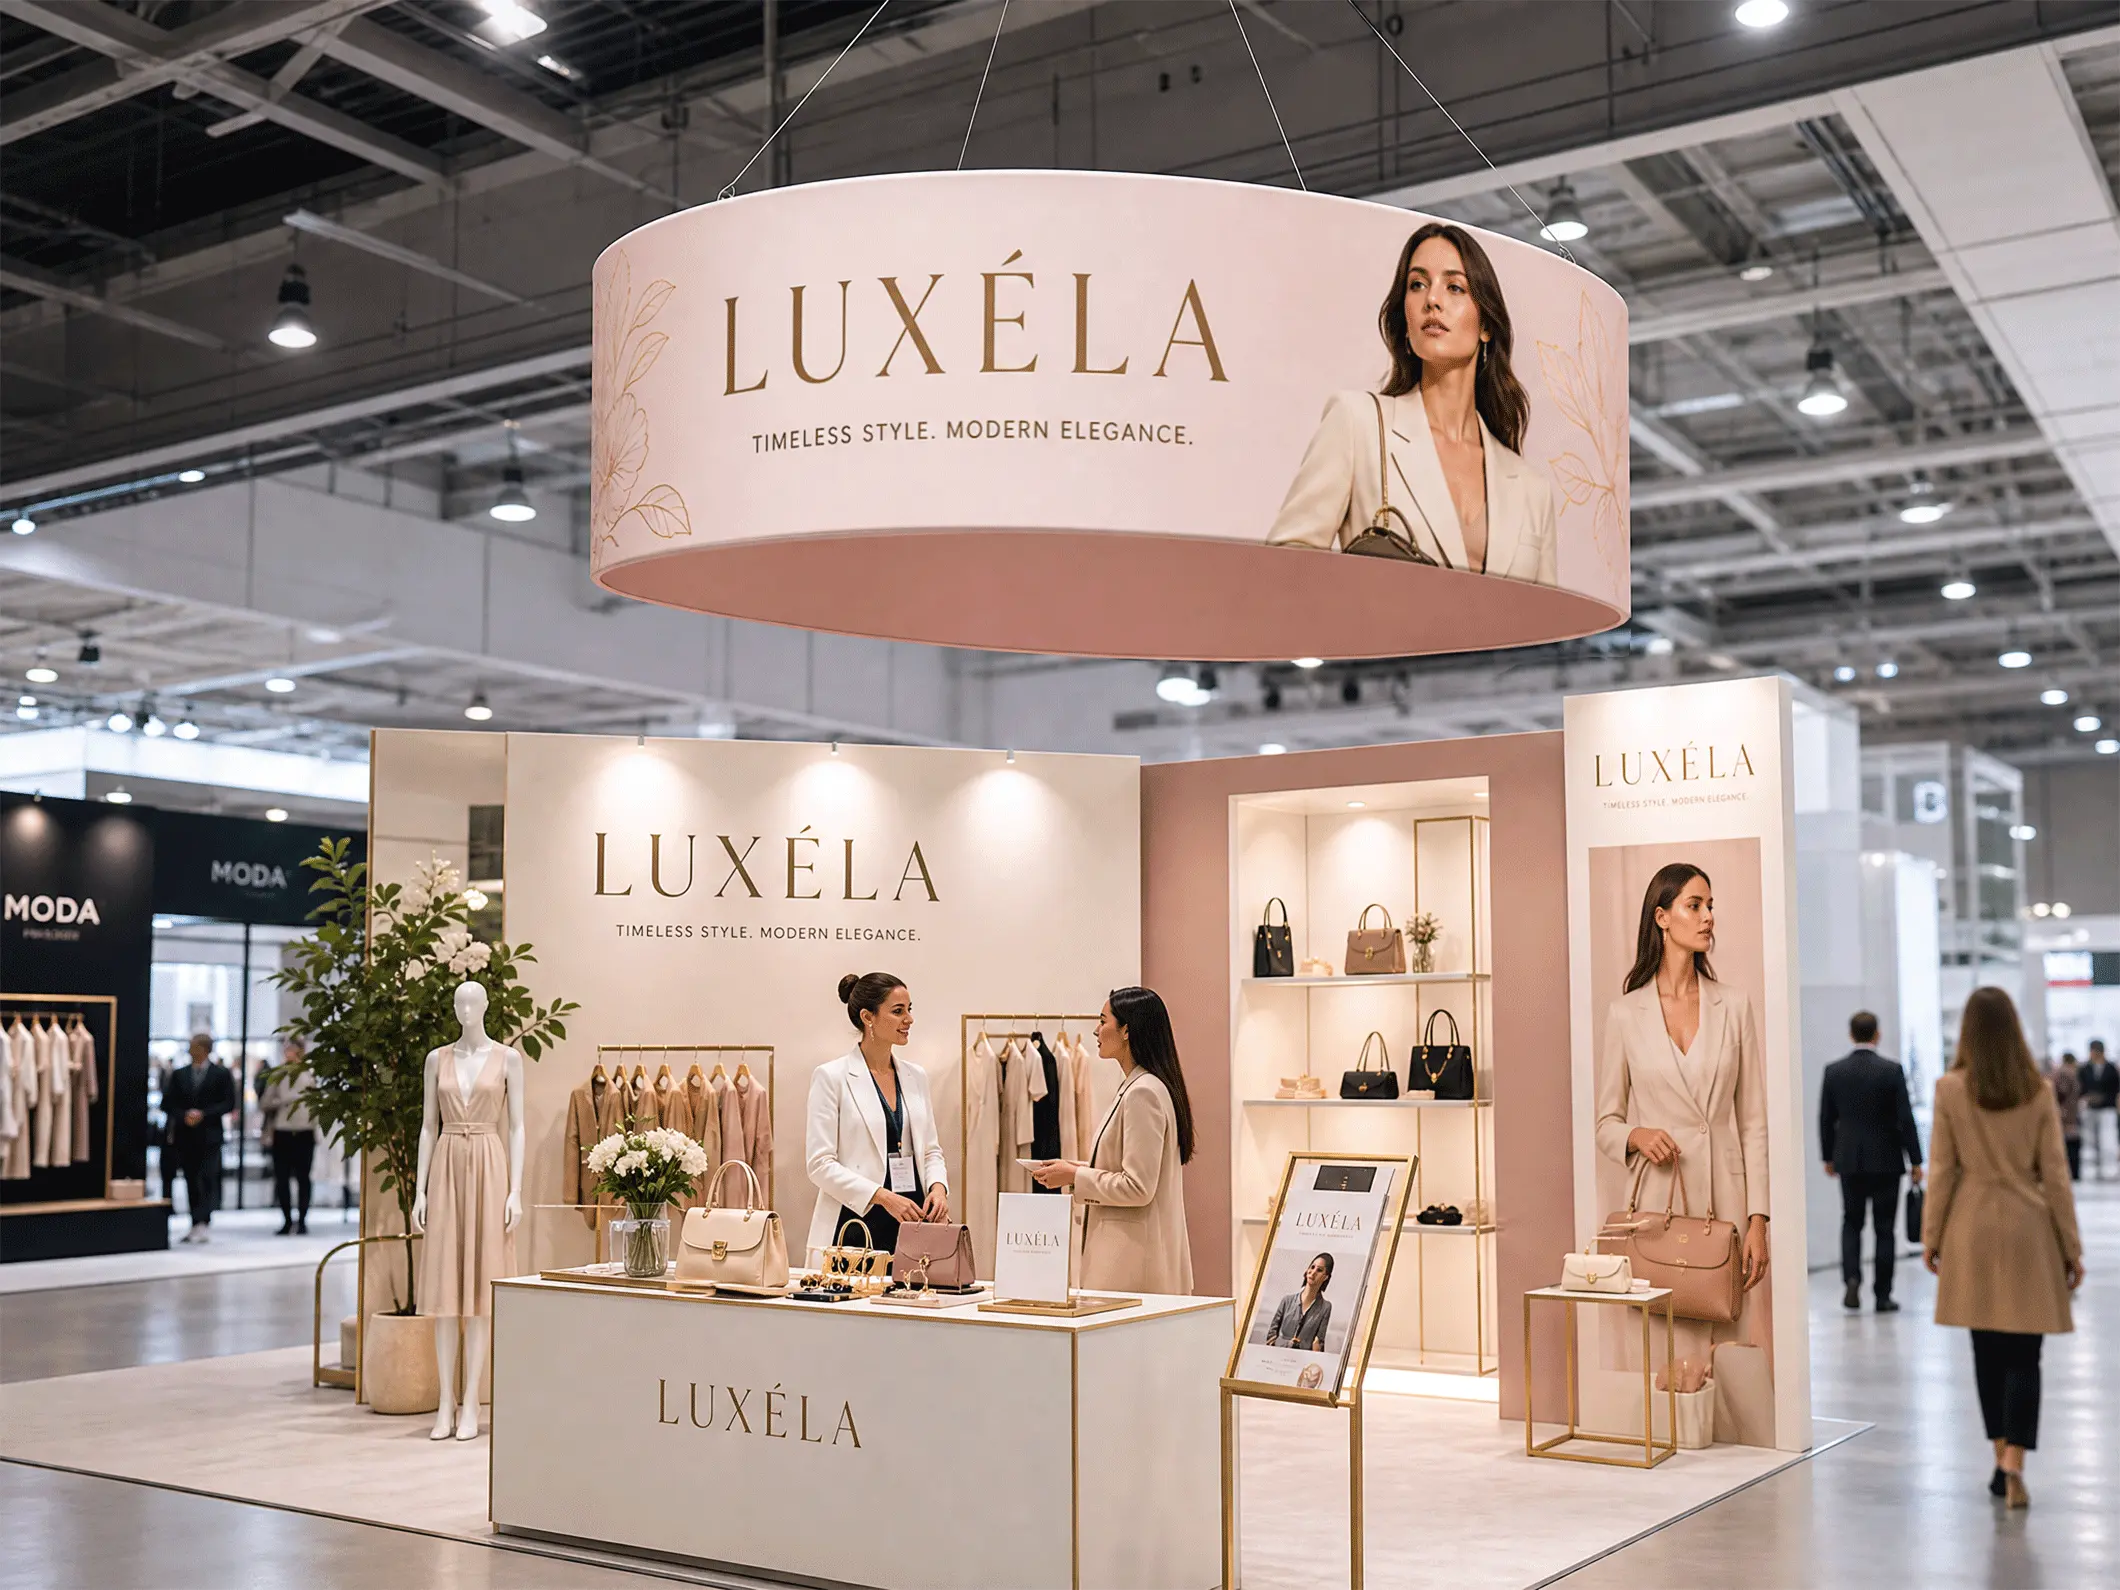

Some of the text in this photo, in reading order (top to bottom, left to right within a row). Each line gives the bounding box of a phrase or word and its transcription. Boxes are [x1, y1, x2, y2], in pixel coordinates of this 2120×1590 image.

[723, 249, 1230, 396] LUXÉLA
[752, 420, 1193, 453] TIMELESS STYLE. MODERN ELEGANCE.
[1595, 741, 1755, 787] LUXÉLA
[1603, 799, 1640, 809] TIMELESS
[1671, 795, 1705, 805] MODERN
[211, 860, 287, 889] MODA
[594, 825, 941, 902] LUXÉLA
[4, 893, 101, 926] MODA
[616, 924, 921, 941] TIMELESS STYLE. MODERN ELEGANCE.
[1296, 1210, 1361, 1231] LUXÉLA
[1006, 1231, 1060, 1247] LUXÉLA
[658, 1378, 862, 1448] LUXÉLA
